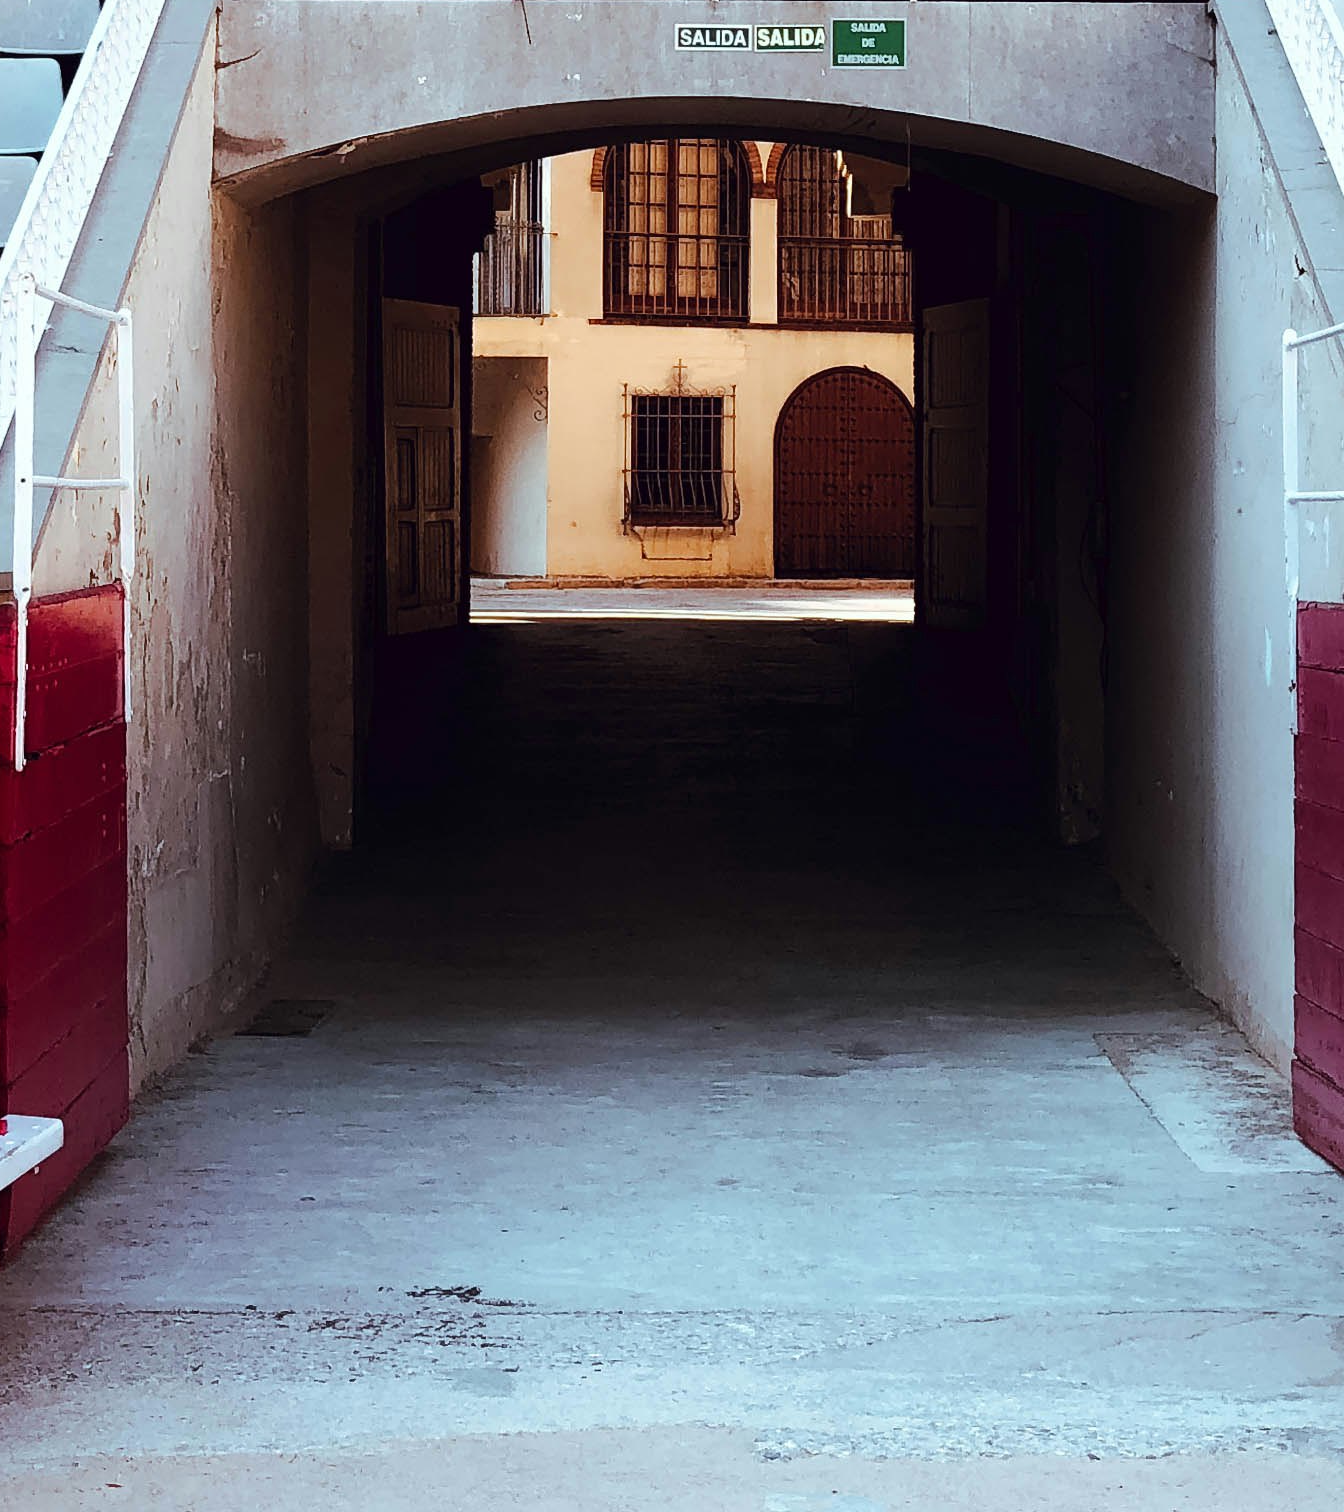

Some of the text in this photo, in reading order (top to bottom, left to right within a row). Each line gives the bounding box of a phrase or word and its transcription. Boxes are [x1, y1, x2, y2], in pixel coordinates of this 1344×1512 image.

[850, 23, 886, 33] SALIDA
[680, 29, 747, 46] SALIDA
[757, 29, 825, 47] SALIDA
[861, 38, 876, 47] DE
[838, 54, 899, 65] EMERGENCIA
